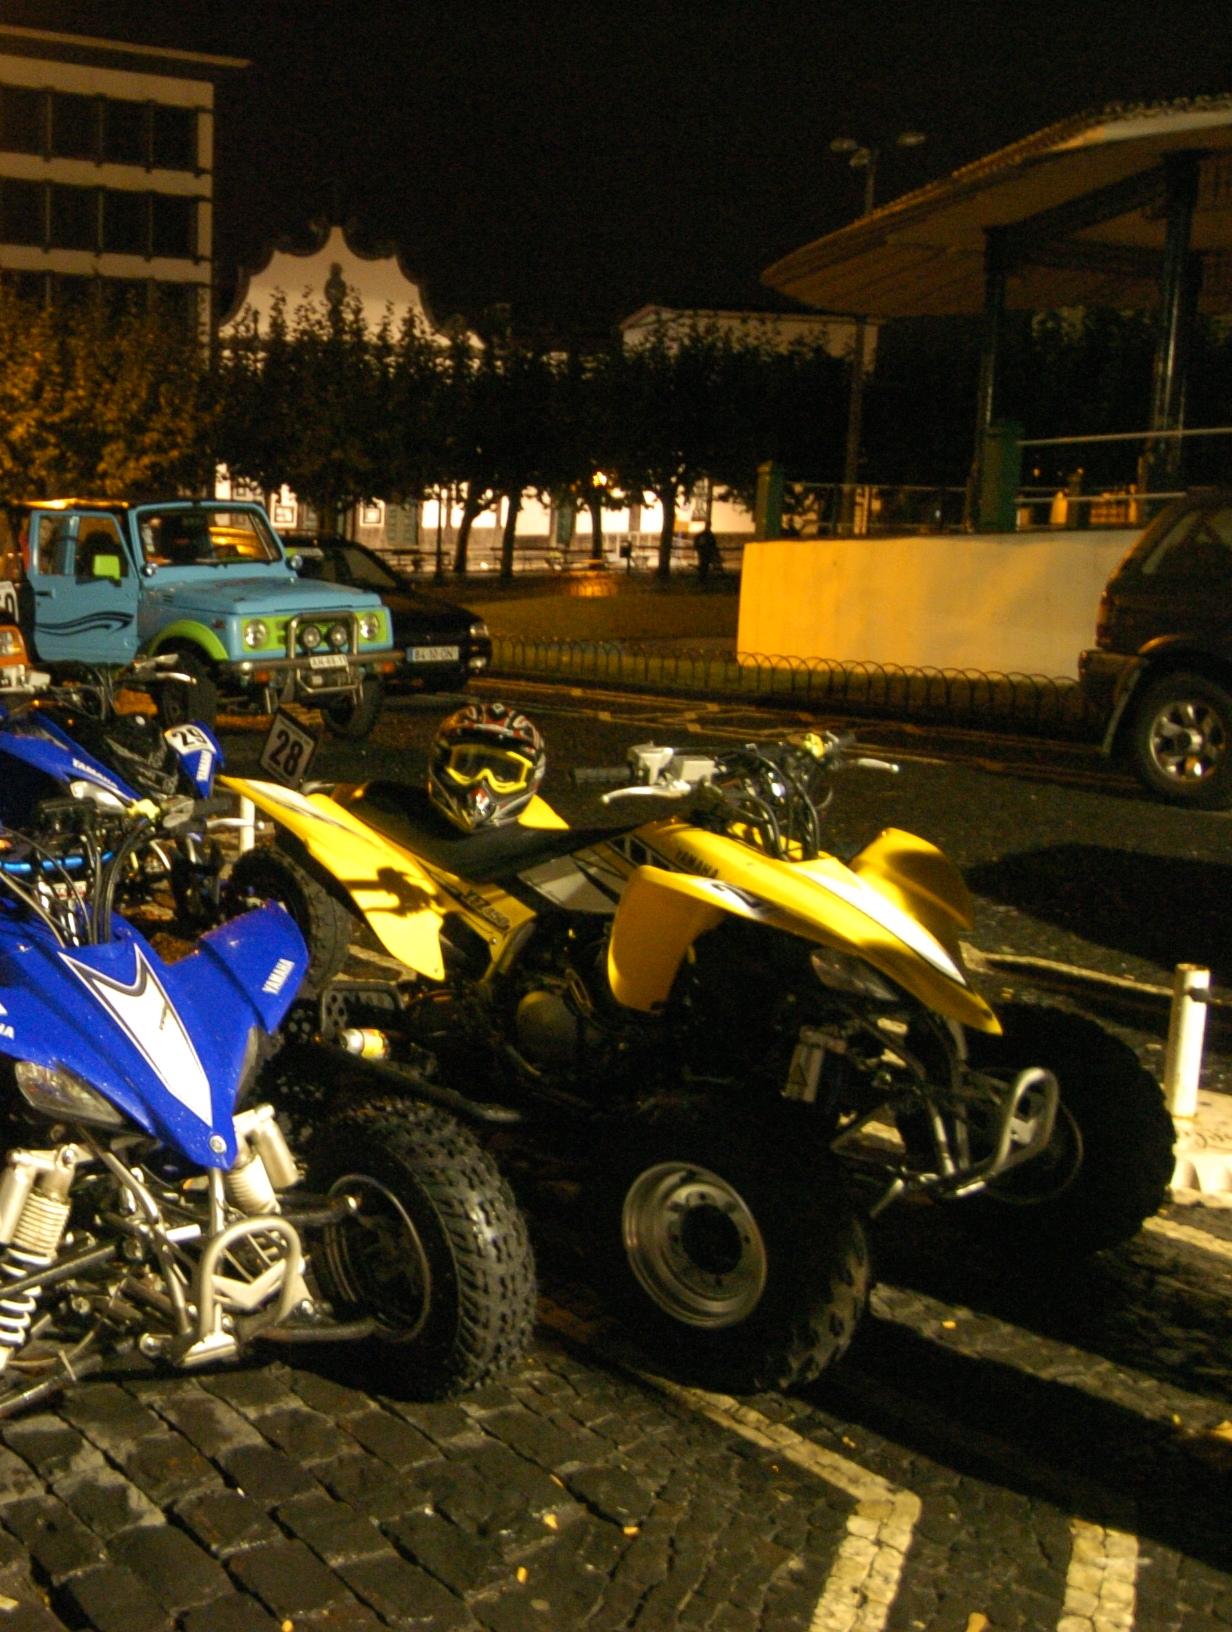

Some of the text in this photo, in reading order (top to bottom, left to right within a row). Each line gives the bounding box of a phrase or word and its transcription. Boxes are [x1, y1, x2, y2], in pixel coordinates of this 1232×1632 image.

[171, 728, 208, 747] 29
[269, 729, 304, 777] 28
[261, 957, 296, 996] YAMAHA
